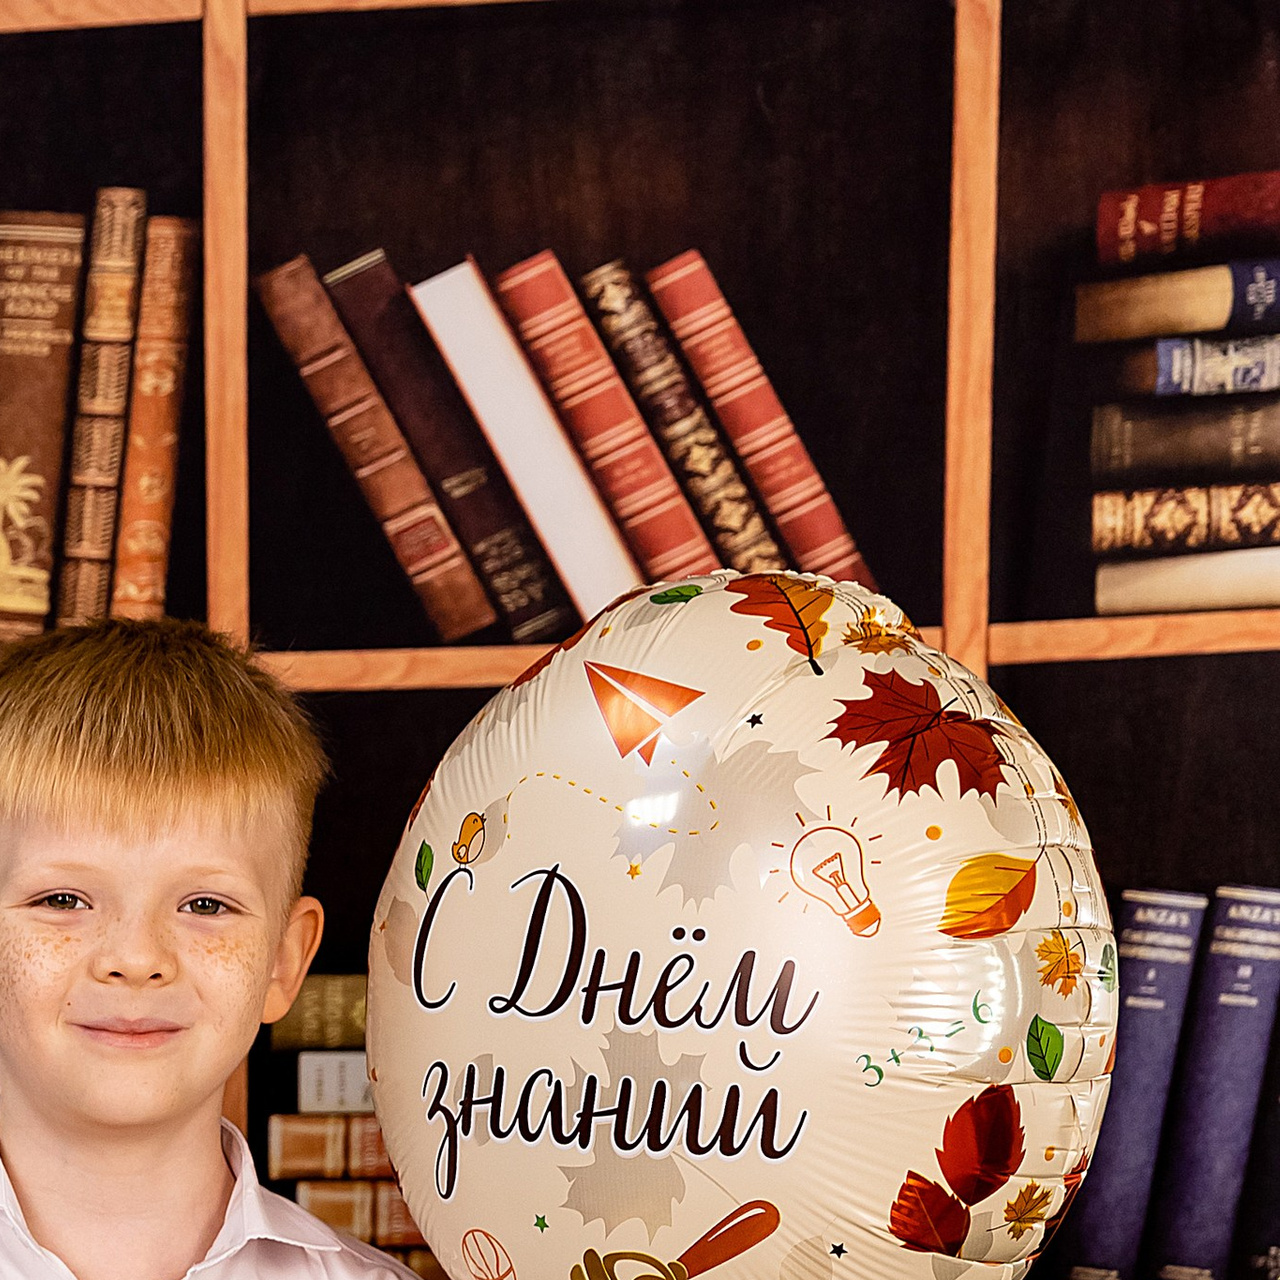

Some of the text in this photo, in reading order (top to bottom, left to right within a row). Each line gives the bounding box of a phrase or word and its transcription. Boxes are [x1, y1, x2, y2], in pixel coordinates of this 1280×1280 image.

[411, 867, 474, 1010] С
[488, 863, 820, 1035] Днём
[421, 1040, 809, 1200] знаний
